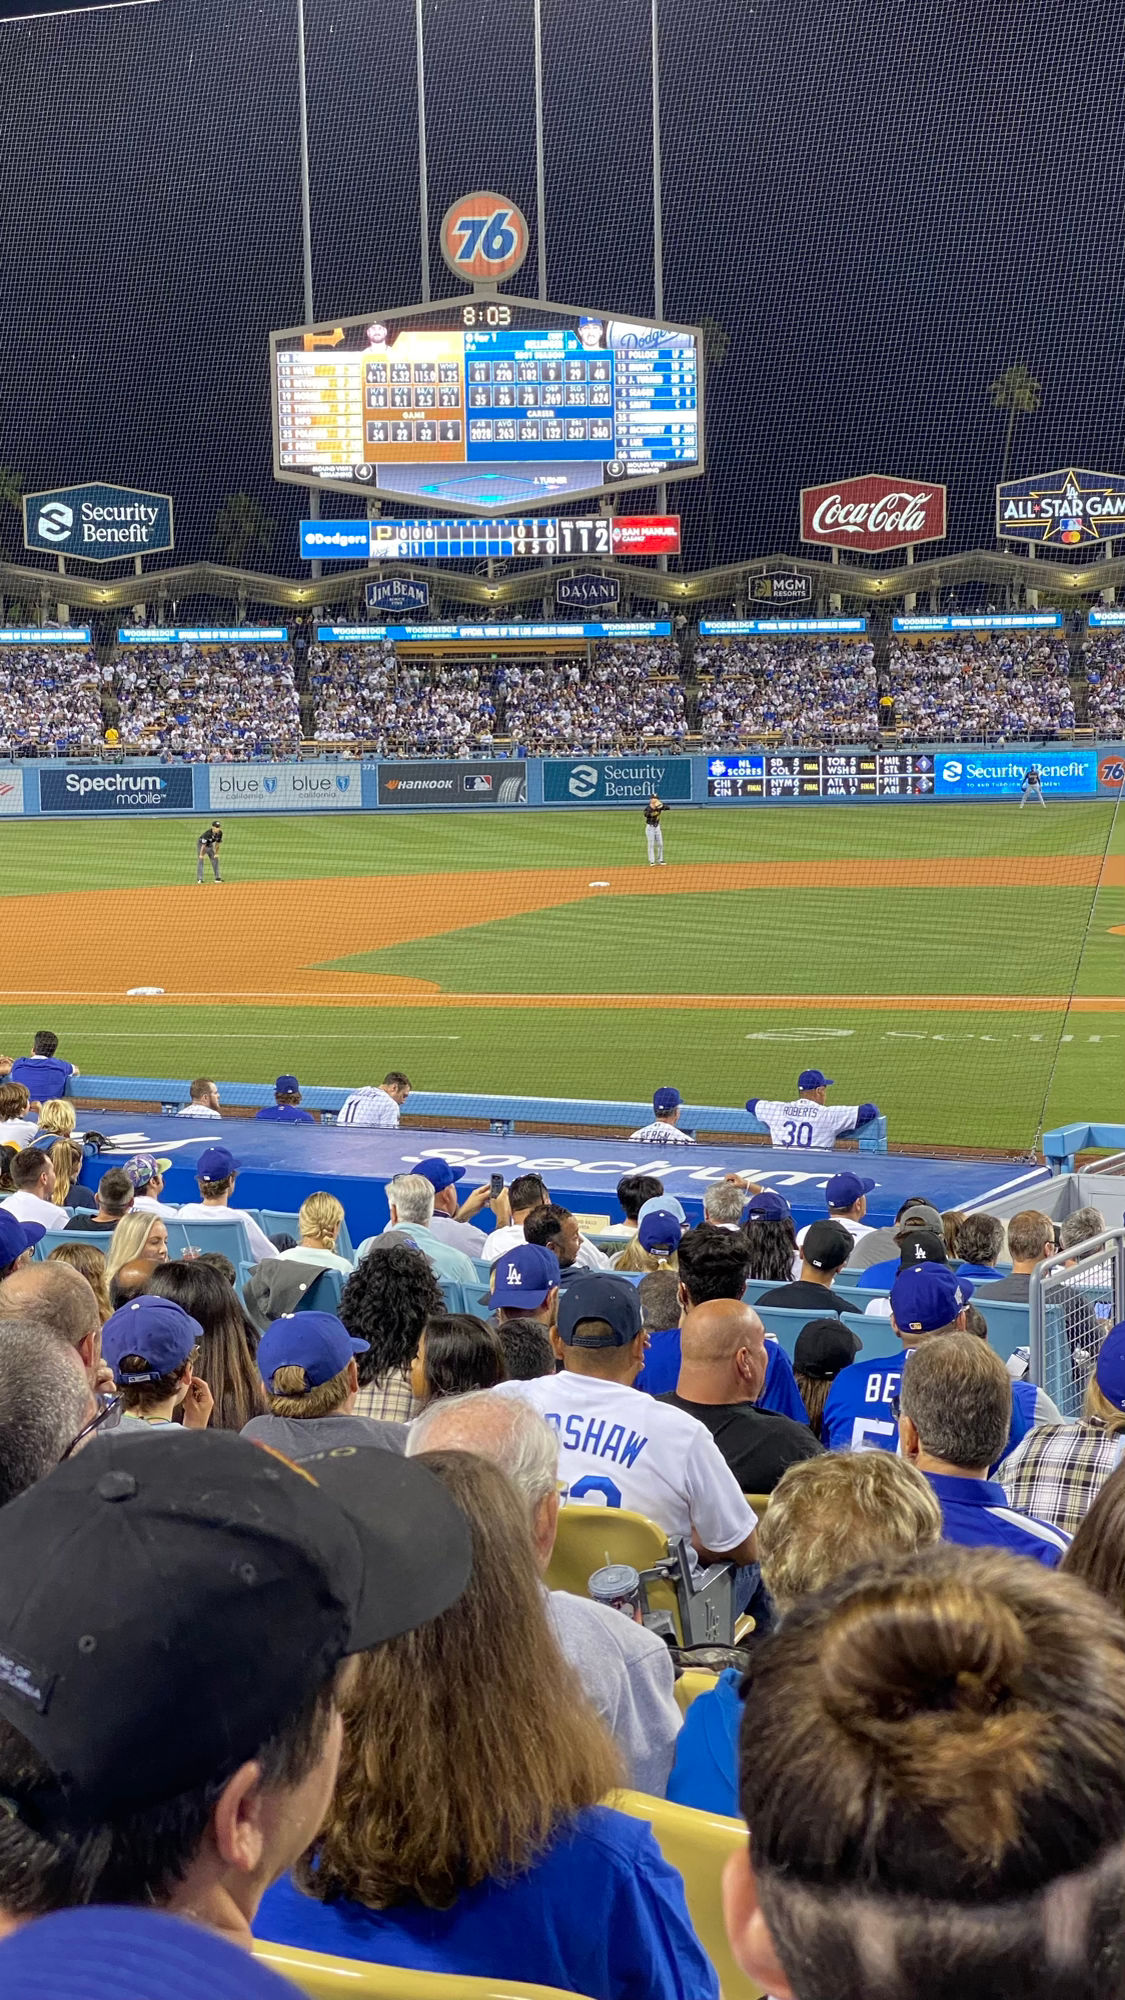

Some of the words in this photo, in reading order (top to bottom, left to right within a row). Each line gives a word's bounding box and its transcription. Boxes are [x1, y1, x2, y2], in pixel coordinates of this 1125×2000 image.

[452, 209, 518, 263] 76
[463, 306, 511, 325] 8:03
[359, 467, 367, 477] 4
[611, 463, 619, 473] 5
[1066, 483, 1079, 500] LA
[81, 502, 159, 526] Security
[812, 492, 933, 533] Coca-Cola
[1004, 501, 1037, 519] ALL
[1040, 499, 1083, 517] STAR
[82, 523, 149, 543] Benefit
[400, 527, 408, 540] 0
[412, 527, 420, 540] 0
[425, 527, 433, 540] 0
[517, 525, 526, 538] 0
[532, 525, 538, 538] 1
[546, 525, 554, 538] 0
[563, 529, 572, 552] 1
[580, 529, 588, 552] 1
[595, 528, 608, 552] 2
[400, 543, 408, 555] 3
[414, 543, 419, 554] 1
[517, 541, 526, 554] 4
[531, 541, 539, 554] 5
[546, 540, 554, 553] 0
[369, 584, 391, 606] JIM
[392, 580, 426, 604] BEAM
[561, 584, 615, 600] DASANI
[773, 581, 806, 591] MGM
[738, 760, 751, 768] NL
[770, 758, 783, 766] SD
[793, 758, 799, 766] 5
[803, 763, 818, 771] FINAL
[827, 757, 846, 766] TOR
[850, 757, 856, 765] 5
[860, 762, 875, 770] FINAL
[884, 757, 900, 765] MIL
[906, 756, 912, 765] 3
[604, 765, 666, 784] Security
[727, 768, 762, 776] SCORES
[770, 767, 790, 775] COL
[793, 767, 800, 775] 7
[827, 767, 849, 775] WSH
[850, 766, 856, 774] 8
[906, 765, 912, 773] 3
[966, 763, 1028, 781] Security
[1102, 764, 1125, 780] 76
[66, 773, 161, 796] Spectrum
[219, 776, 259, 792] blue
[292, 775, 331, 792] blue
[605, 780, 658, 796] Benefit
[714, 780, 731, 788] CHI
[771, 779, 792, 787] NYM
[793, 779, 800, 787] 6
[803, 783, 818, 791] FINAL
[827, 778, 844, 786] ATL
[849, 778, 858, 786] 11
[884, 777, 899, 785] PHI
[908, 777, 912, 785] 1
[226, 792, 264, 800] california
[771, 788, 782, 796] SF
[850, 786, 856, 794] 9
[883, 786, 900, 794] ARI
[117, 792, 162, 805] mobile
[346, 1099, 359, 1123] 11
[784, 1105, 818, 1118] ROBERTS
[782, 1121, 813, 1148] 30
[401, 1147, 836, 1189] Spectrum
[914, 1243, 926, 1259] LA
[506, 1263, 522, 1285] LA
